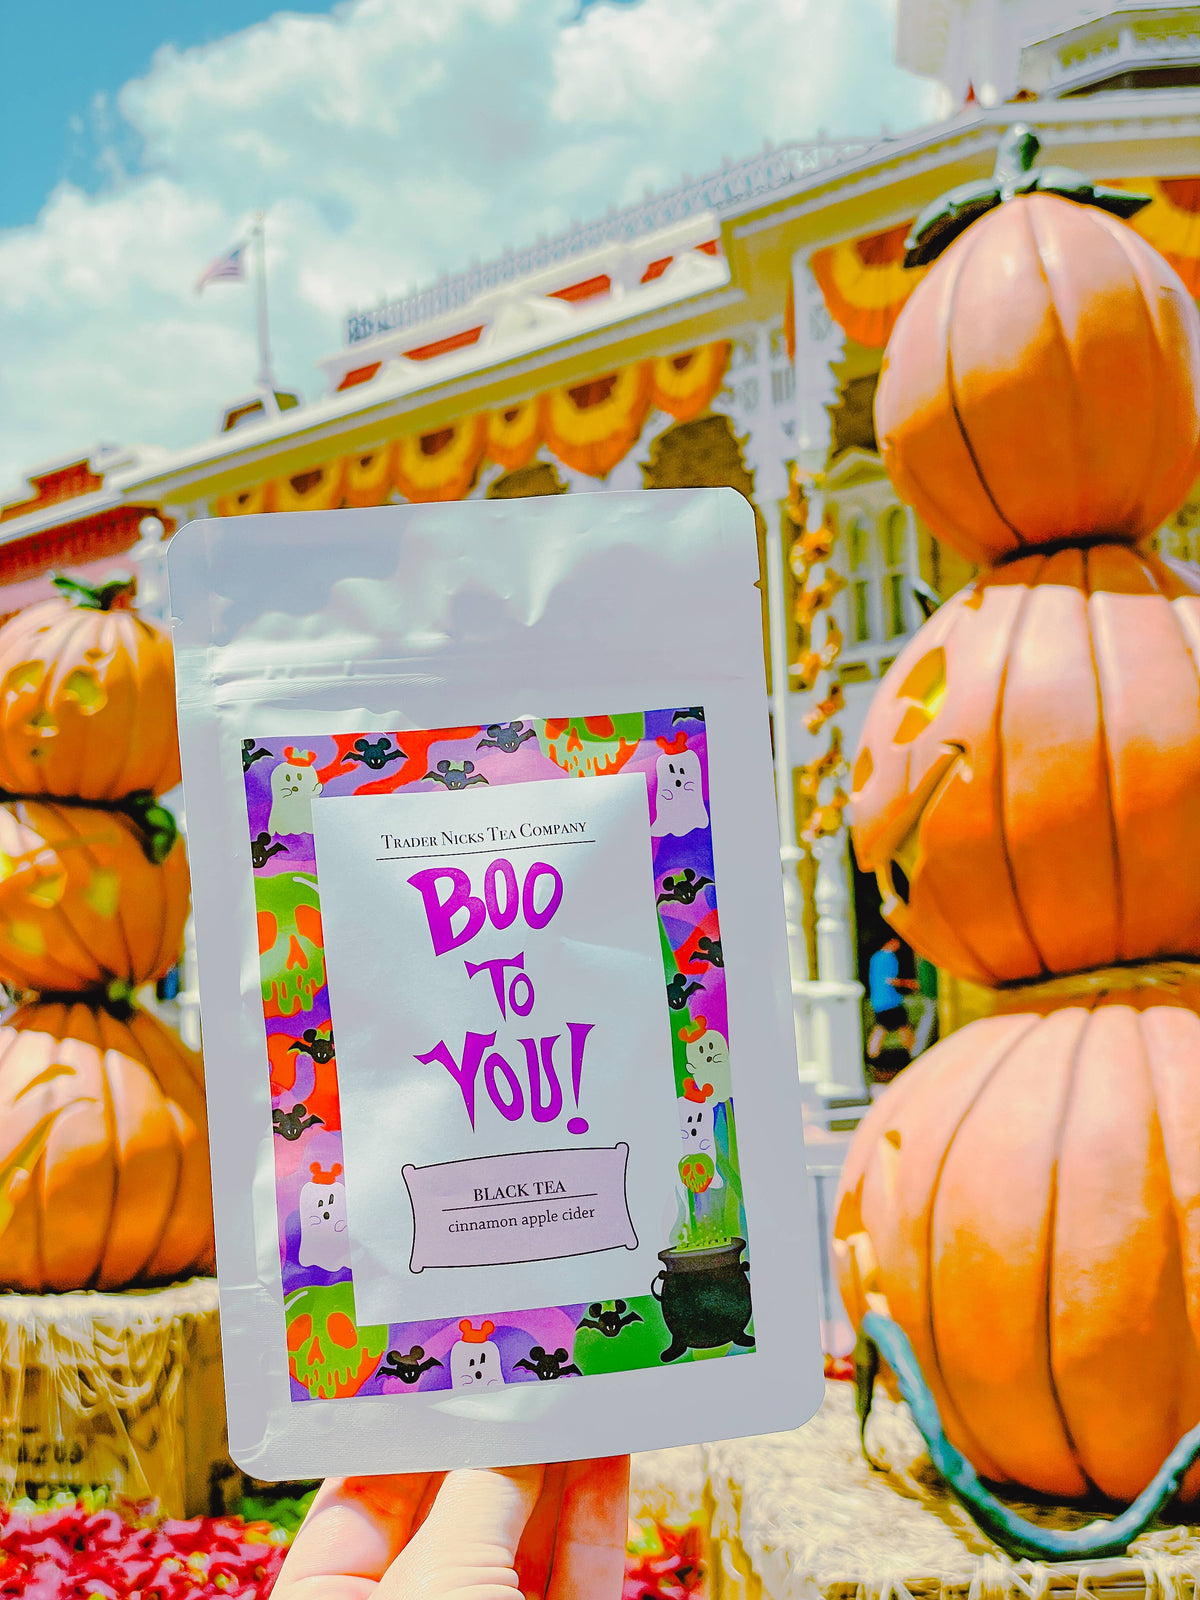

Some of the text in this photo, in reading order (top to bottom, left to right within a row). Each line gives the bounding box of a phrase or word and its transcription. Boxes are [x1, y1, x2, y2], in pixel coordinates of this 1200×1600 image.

[487, 826, 517, 841] TEA
[406, 858, 563, 957] BOO
[412, 1022, 596, 1134] YOU!
[473, 1180, 567, 1202] BLACK TEA
[448, 1206, 596, 1233] cinnamon apple cider
